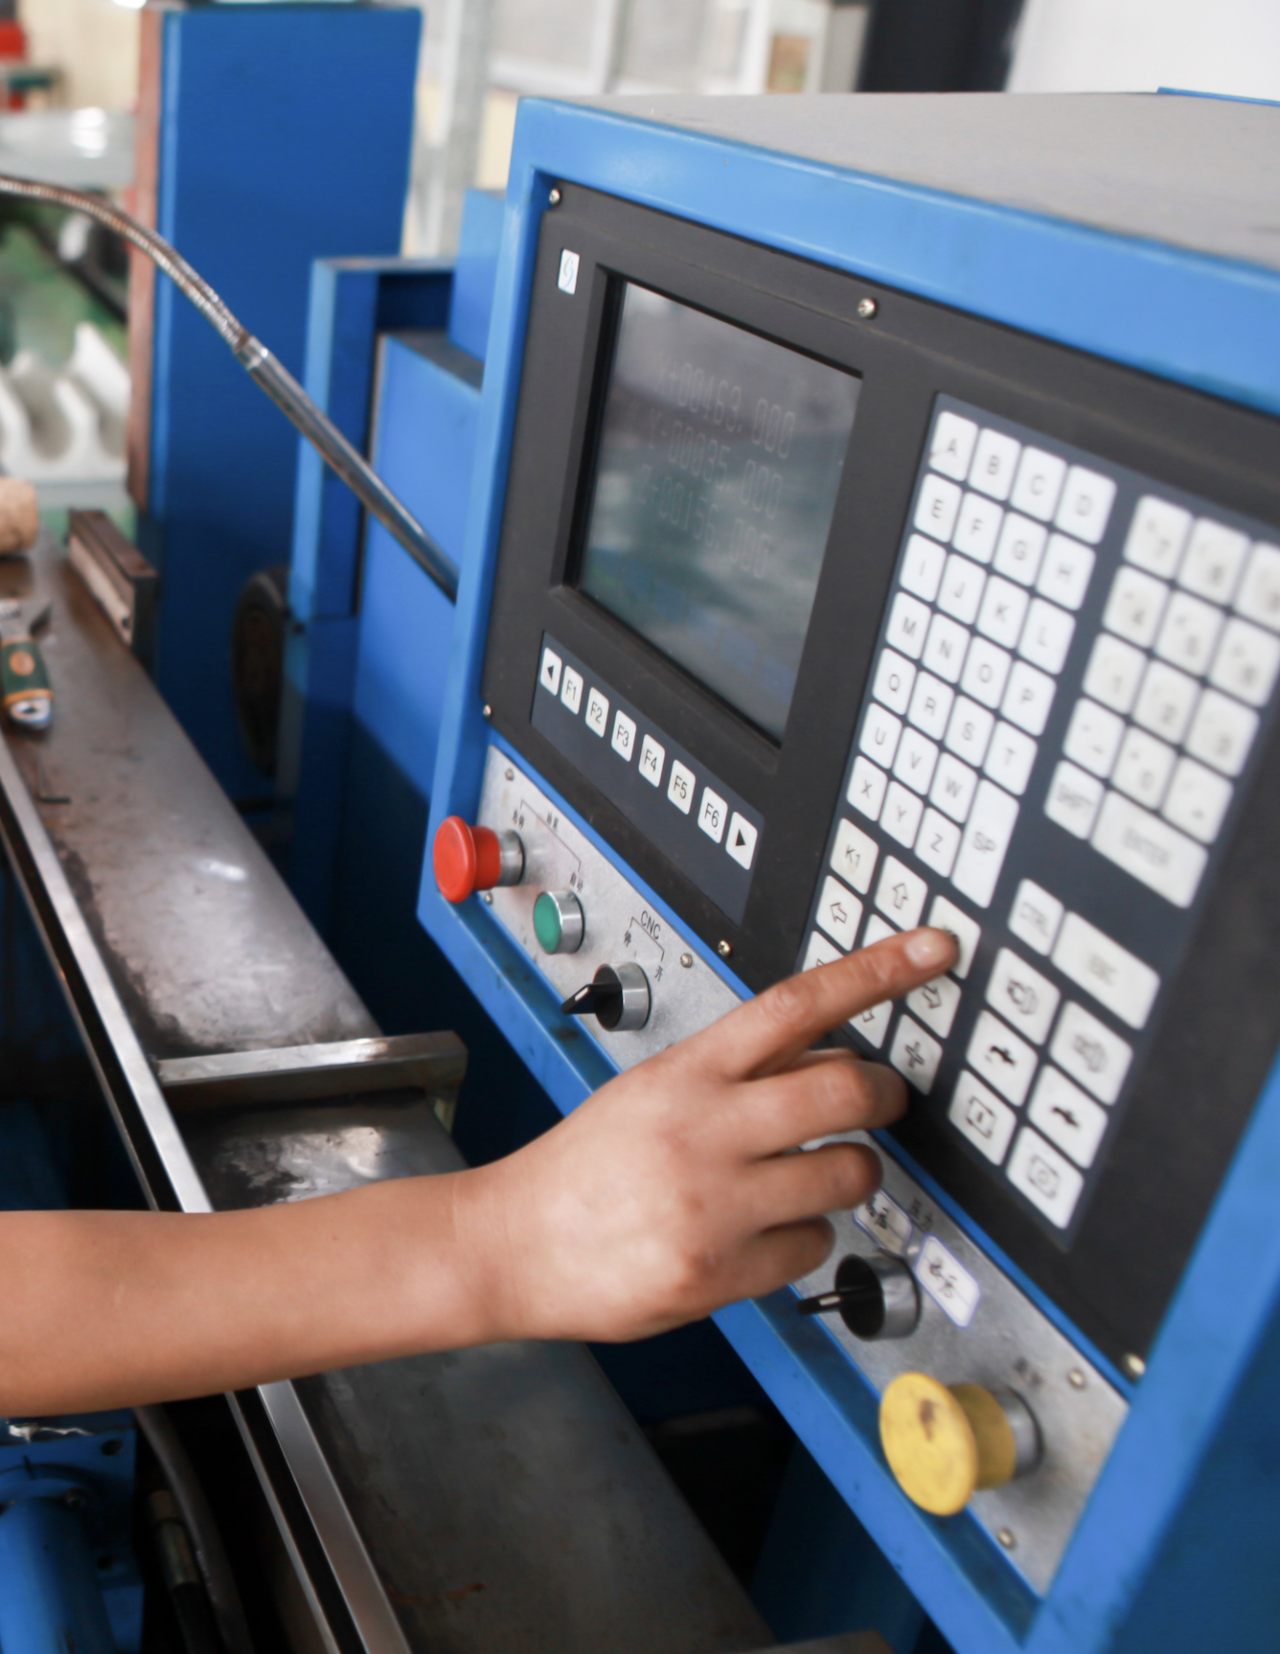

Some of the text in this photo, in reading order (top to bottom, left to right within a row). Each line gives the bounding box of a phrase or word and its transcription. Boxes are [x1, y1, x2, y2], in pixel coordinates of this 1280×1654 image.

[946, 437, 959, 458] A
[986, 454, 1001, 476] B
[1028, 474, 1046, 496] C
[931, 498, 945, 520] E
[970, 517, 984, 537] F
[1012, 539, 1029, 561] G
[953, 580, 965, 599] J
[994, 602, 1009, 624] K
[902, 615, 917, 638] M
[1036, 625, 1048, 648] L
[939, 638, 953, 660] N
[565, 679, 578, 701] F1
[888, 673, 901, 693] Q
[589, 701, 604, 725] F2
[923, 696, 937, 718] R
[615, 723, 630, 748] F3
[874, 726, 887, 746] U
[643, 748, 658, 773] F4
[910, 750, 922, 770] V
[1003, 747, 1017, 767] T
[672, 774, 688, 800] F5
[860, 778, 873, 800] X
[945, 776, 962, 799] W
[703, 802, 720, 828] F6
[896, 804, 908, 824] Y
[930, 832, 944, 853] Z
[972, 831, 997, 855] SP
[845, 843, 861, 869] K1
[640, 909, 662, 940] CNC
